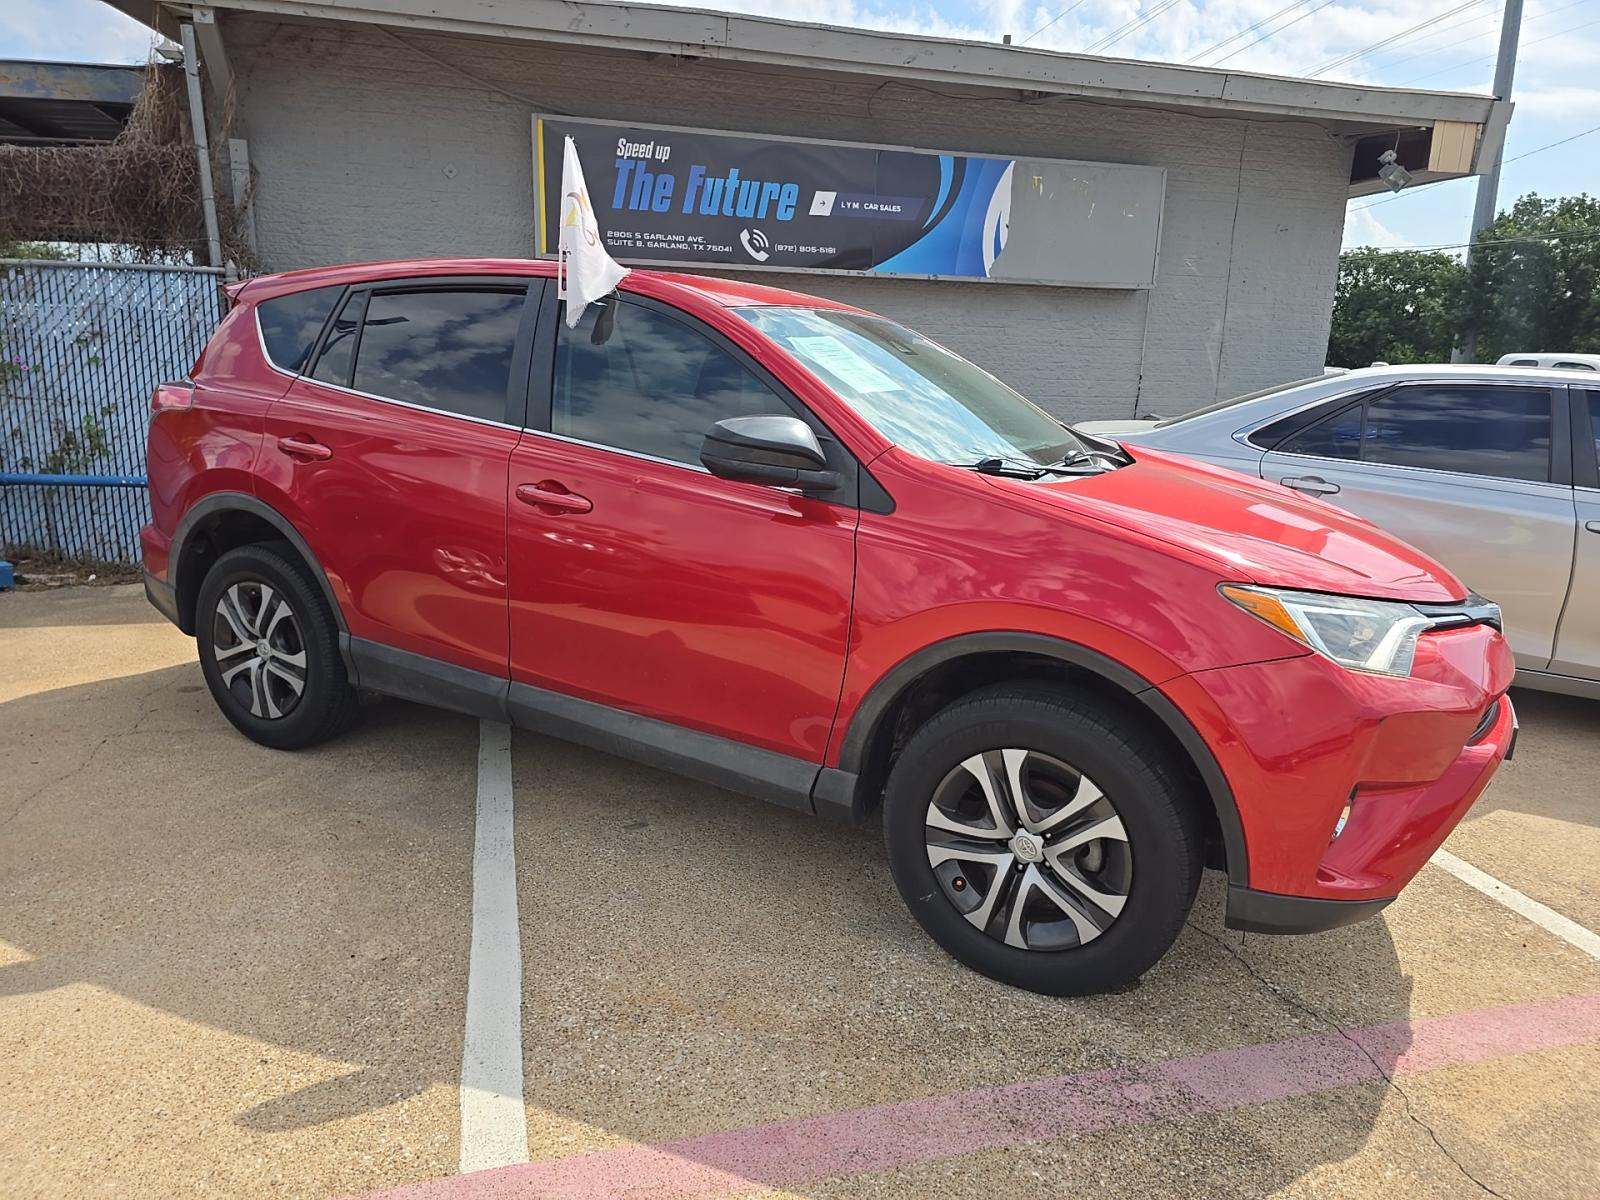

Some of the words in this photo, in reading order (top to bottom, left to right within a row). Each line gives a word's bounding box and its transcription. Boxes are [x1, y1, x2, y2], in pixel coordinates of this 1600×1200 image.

[616, 138, 654, 159] Speed
[655, 145, 671, 162] up
[612, 159, 675, 213] The
[682, 165, 799, 221] Future
[864, 203, 878, 211] CAR
[880, 204, 902, 212] SALES
[607, 230, 632, 238] 2805
[644, 233, 684, 242] GARLAND
